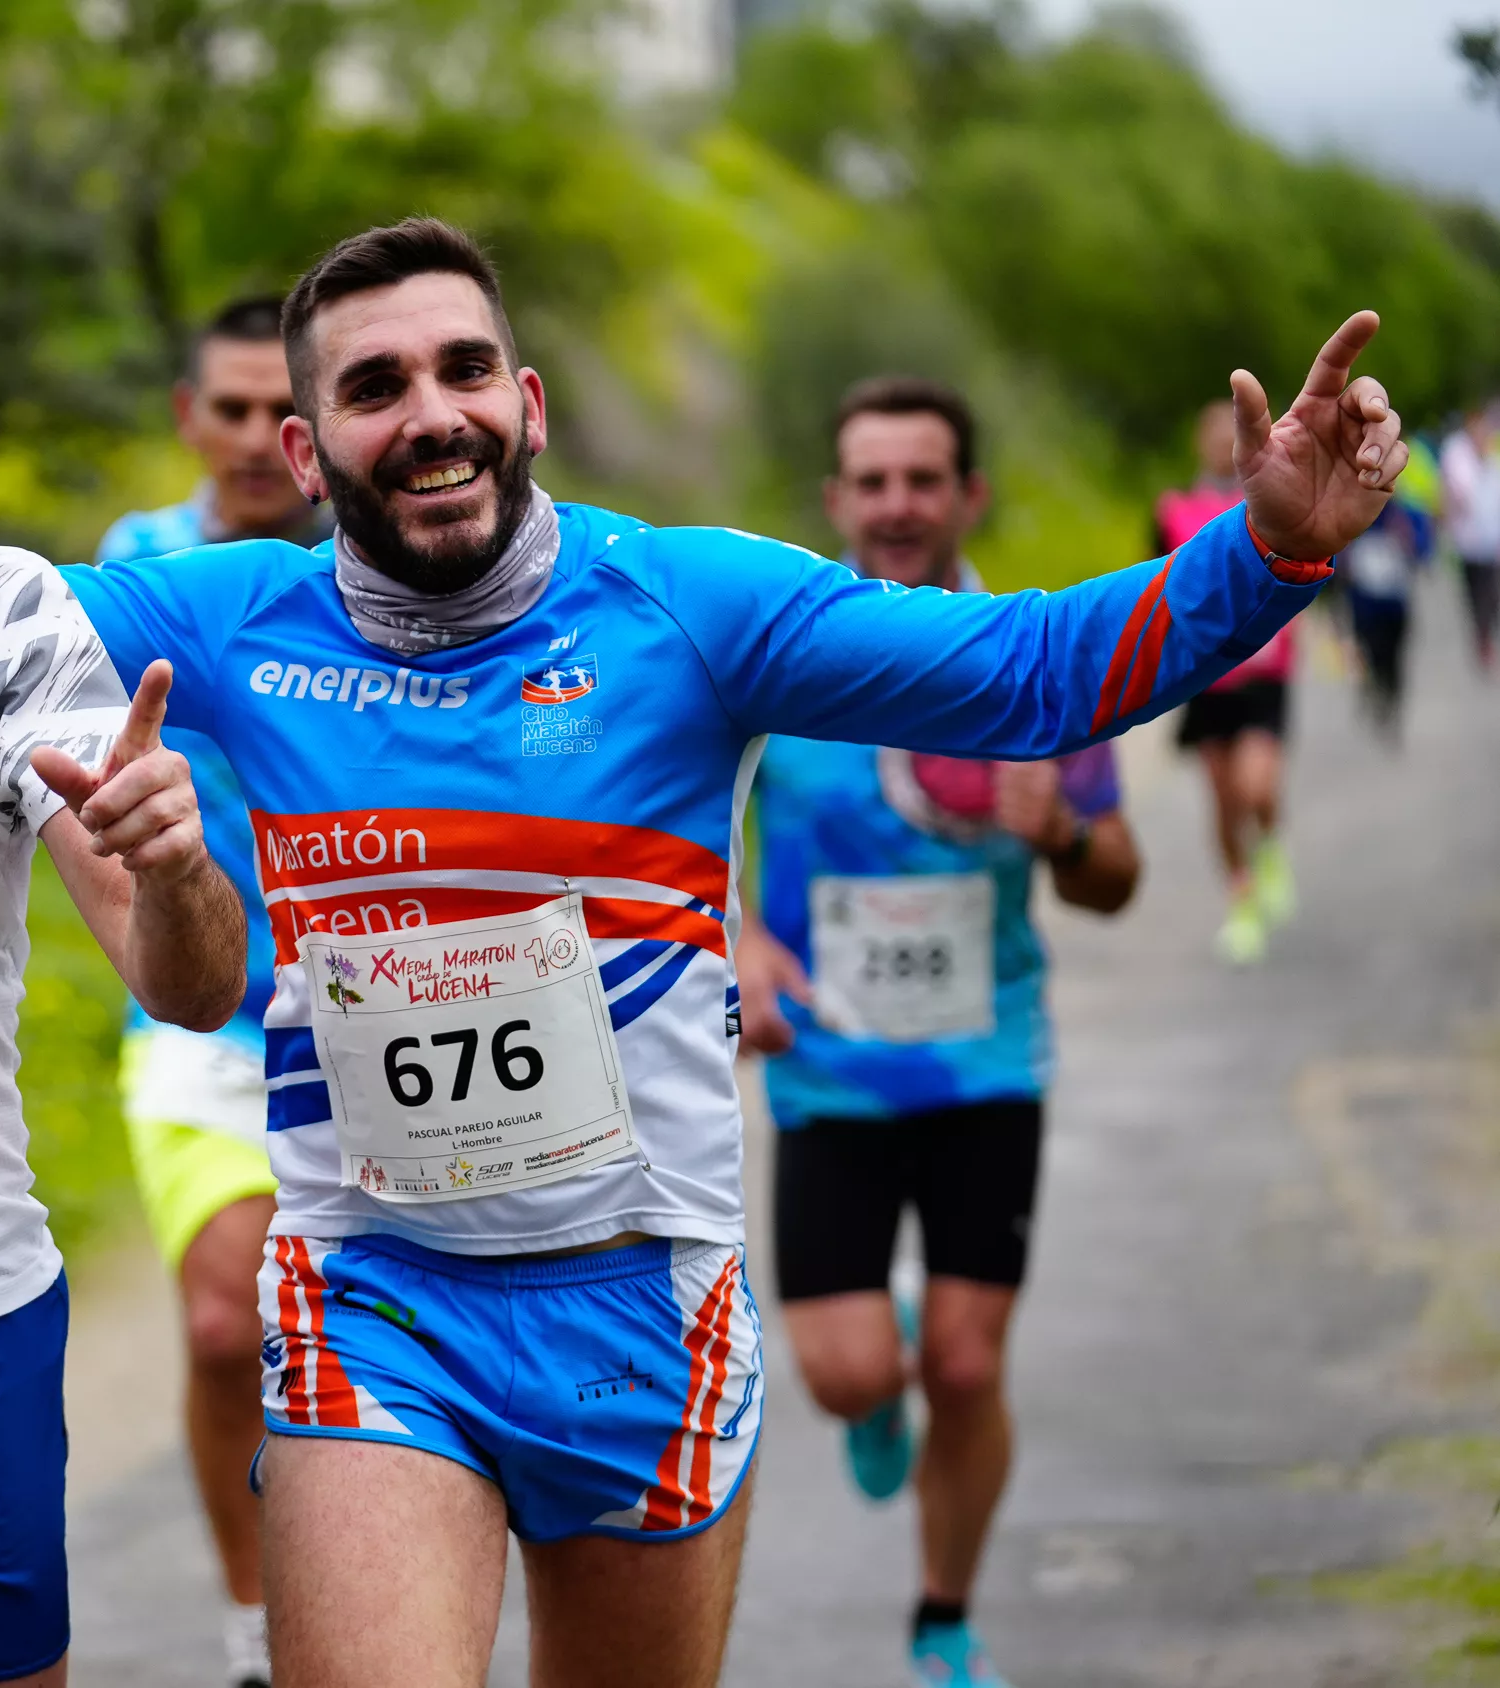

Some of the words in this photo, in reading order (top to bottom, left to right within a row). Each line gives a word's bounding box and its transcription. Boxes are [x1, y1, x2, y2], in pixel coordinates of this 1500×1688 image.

[250, 660, 471, 712] enerplus
[522, 705, 569, 723] Club
[522, 715, 603, 740] Maratón
[522, 738, 597, 757] Lucena
[443, 943, 516, 971] MARATÓN
[408, 972, 505, 1004] LUCENA
[384, 1019, 544, 1107] 676
[408, 1127, 453, 1139] PASCUAL
[455, 1120, 494, 1135] PAREJO
[497, 1111, 543, 1128] AGUILAR
[452, 1135, 503, 1150] L-Hombre
[523, 1127, 621, 1164] mediamaratonlucena.com
